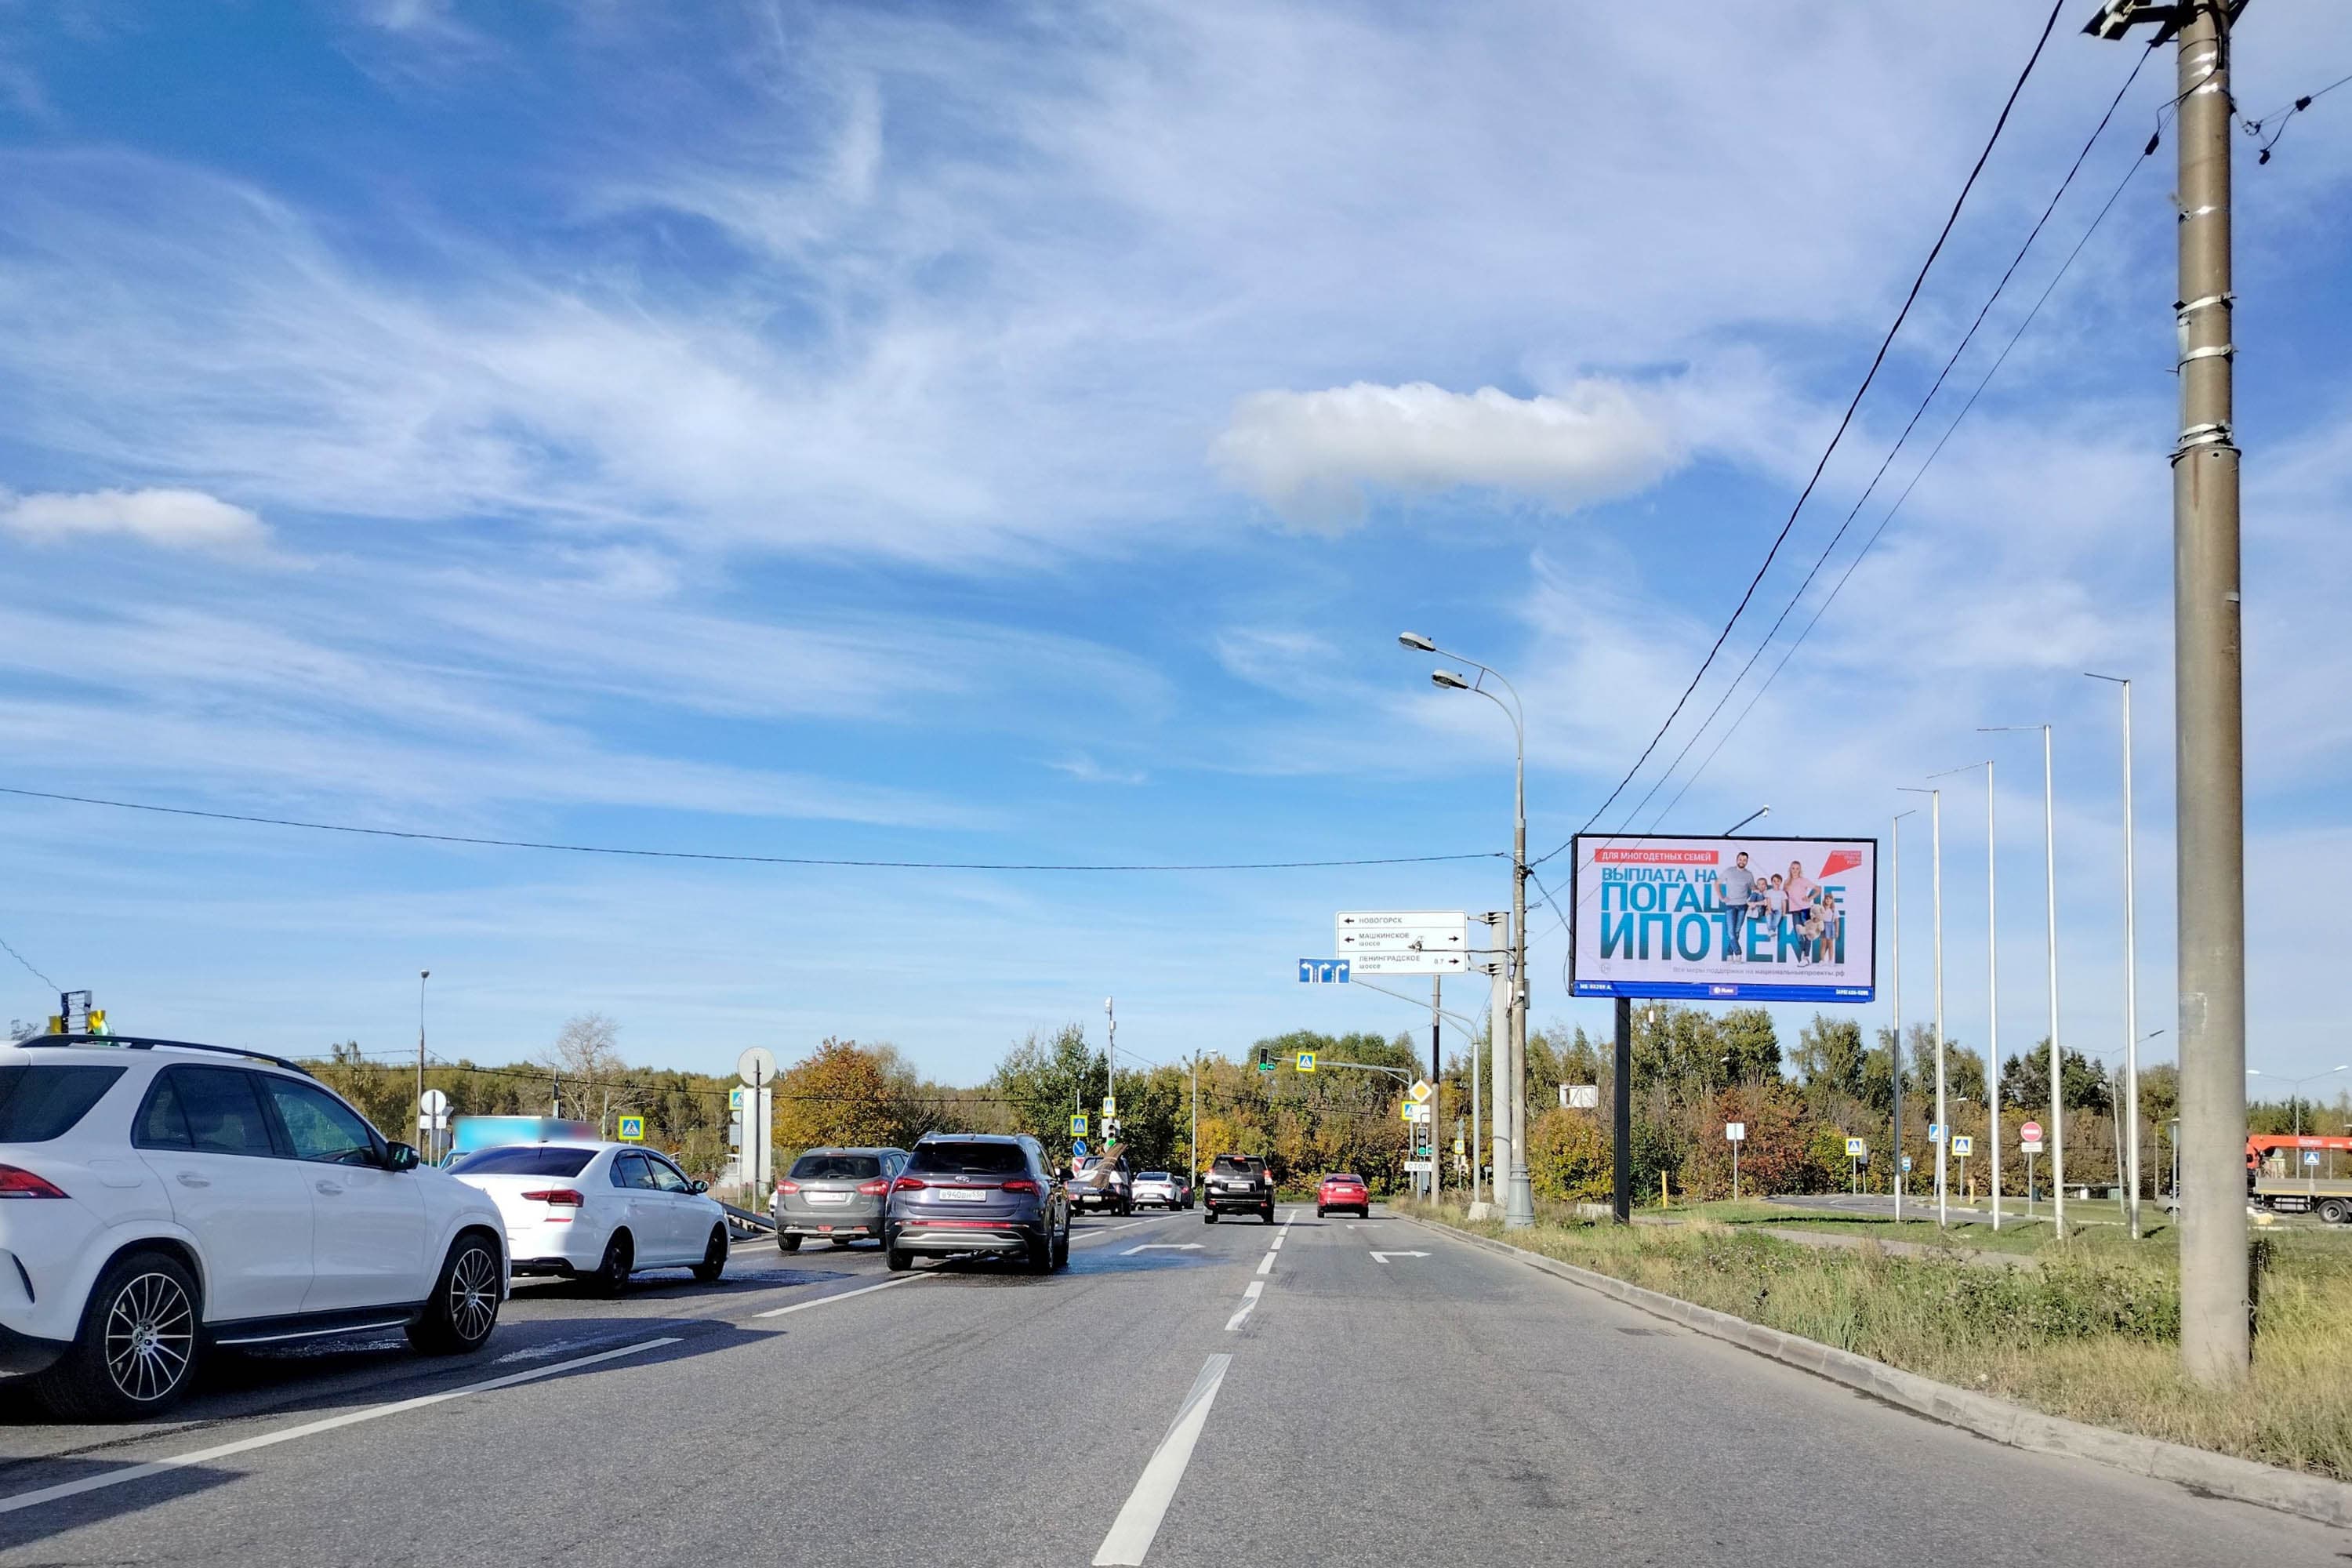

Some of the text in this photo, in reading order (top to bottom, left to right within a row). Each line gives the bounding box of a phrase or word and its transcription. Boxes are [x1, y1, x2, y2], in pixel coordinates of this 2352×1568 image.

[1602, 851, 1711, 862] ДЛЯ МНОГОДЕТНЫХ СЕМЕЙ
[1602, 867, 1719, 883] ВЫПЛАТА НА
[1601, 882, 1846, 916] ПОГАШЕ
